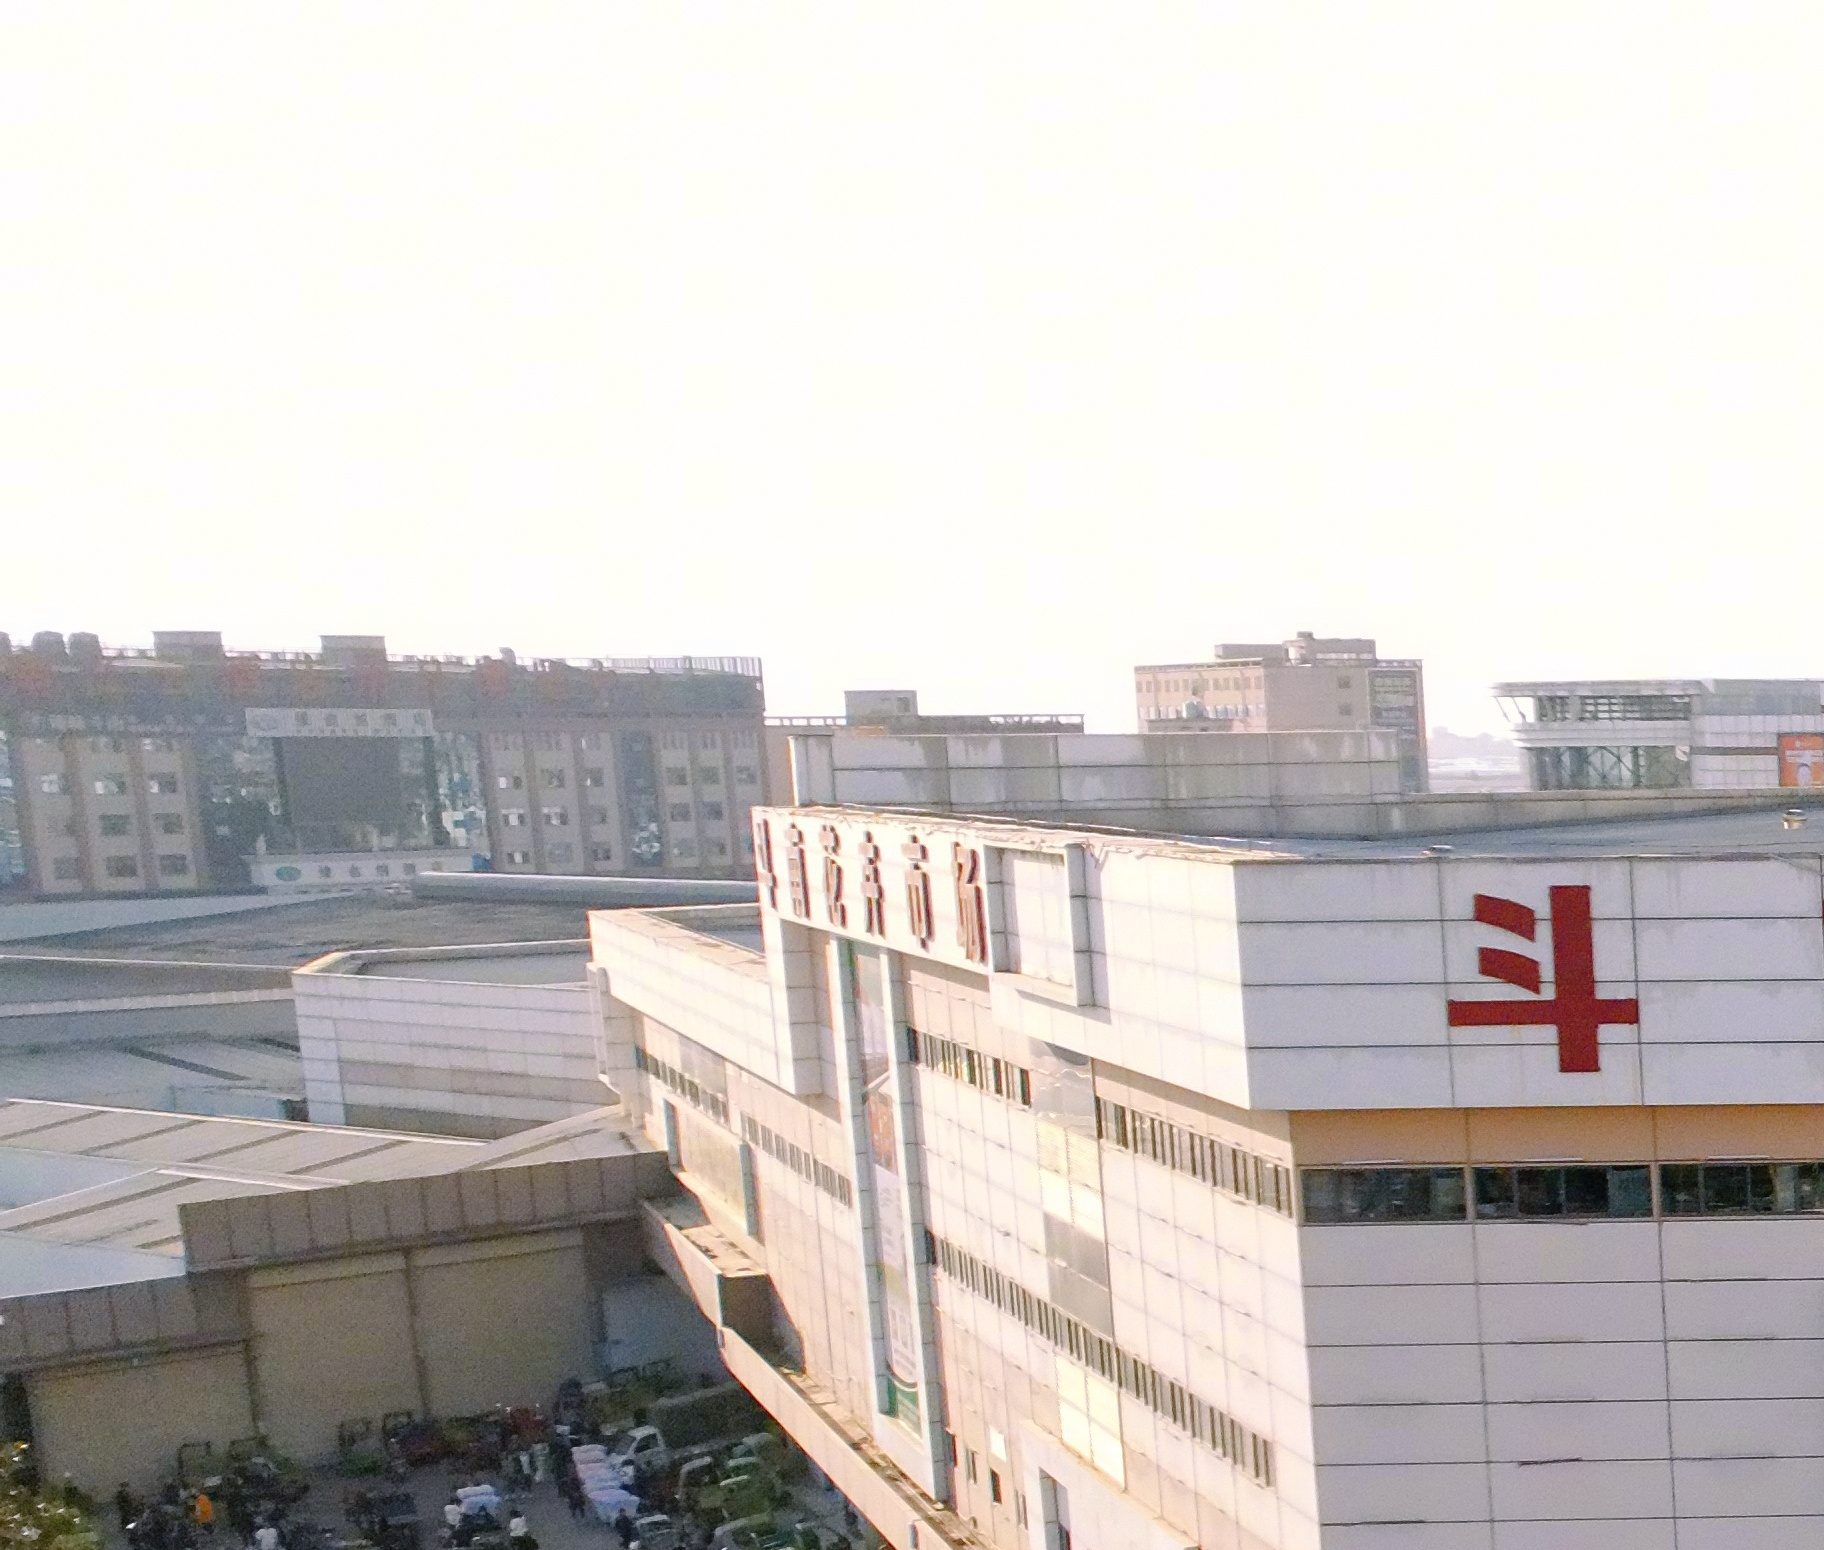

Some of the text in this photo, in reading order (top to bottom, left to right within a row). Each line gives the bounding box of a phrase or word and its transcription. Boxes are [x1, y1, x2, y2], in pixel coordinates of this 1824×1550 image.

[756, 818, 988, 966] 斗南花卉市场
